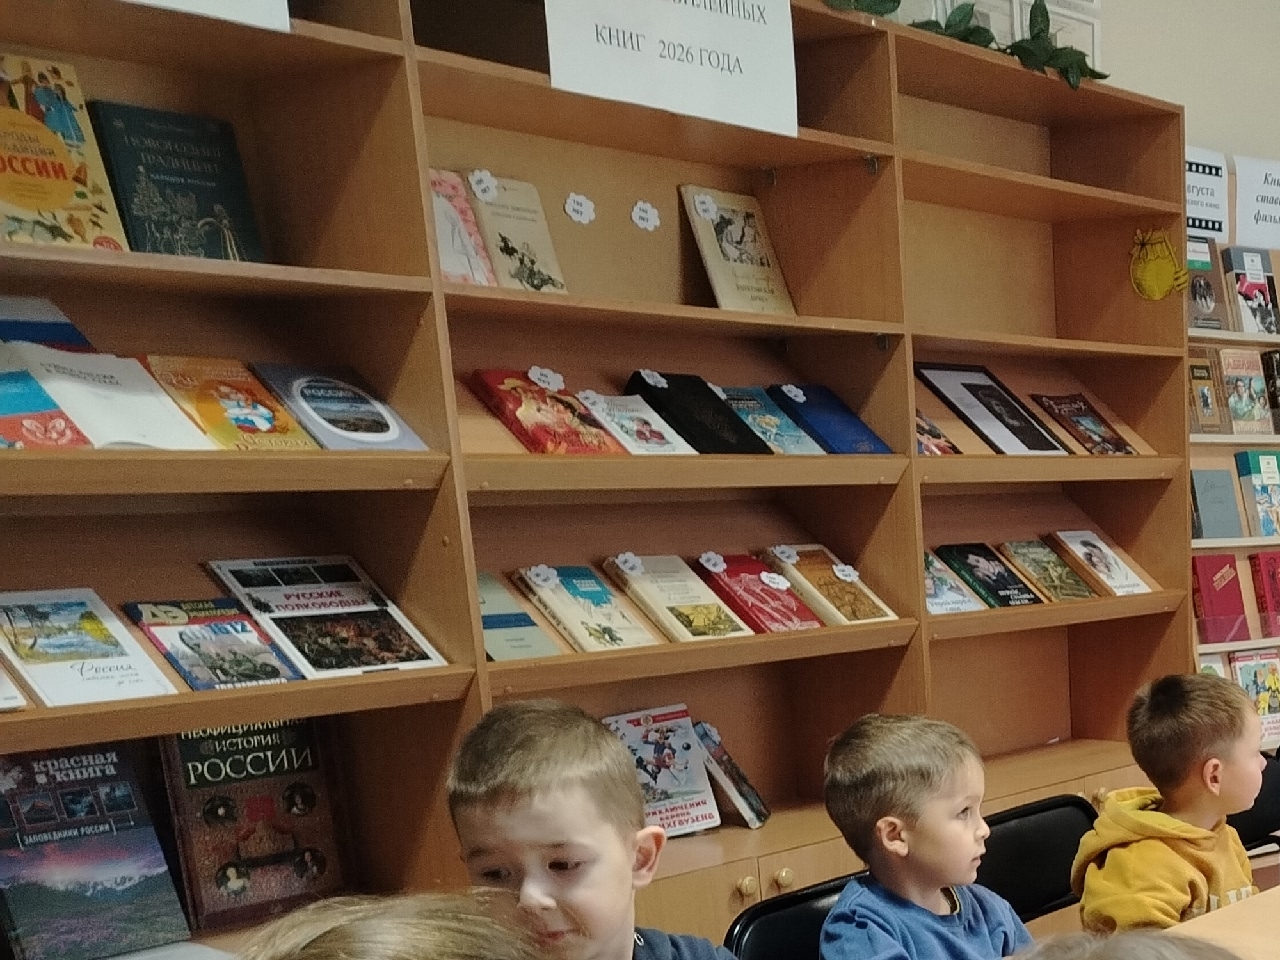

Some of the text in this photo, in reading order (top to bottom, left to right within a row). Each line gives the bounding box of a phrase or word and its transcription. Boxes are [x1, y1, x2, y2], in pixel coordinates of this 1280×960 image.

[595, 24, 743, 75] КНИГ 2026 ГОДА
[0, 154, 68, 181] ОССИИ
[1187, 184, 1215, 197] вгуста
[1187, 199, 1205, 208] ского
[282, 589, 346, 601] РУССКИЕ
[214, 732, 281, 753] ИСТОРИЯ
[186, 747, 314, 786] РОССИИ
[645, 799, 708, 819] РИКЛЮЧЕНИЯ
[23, 823, 110, 845] ЗАПОВЕДНИКИ РОССИИ
